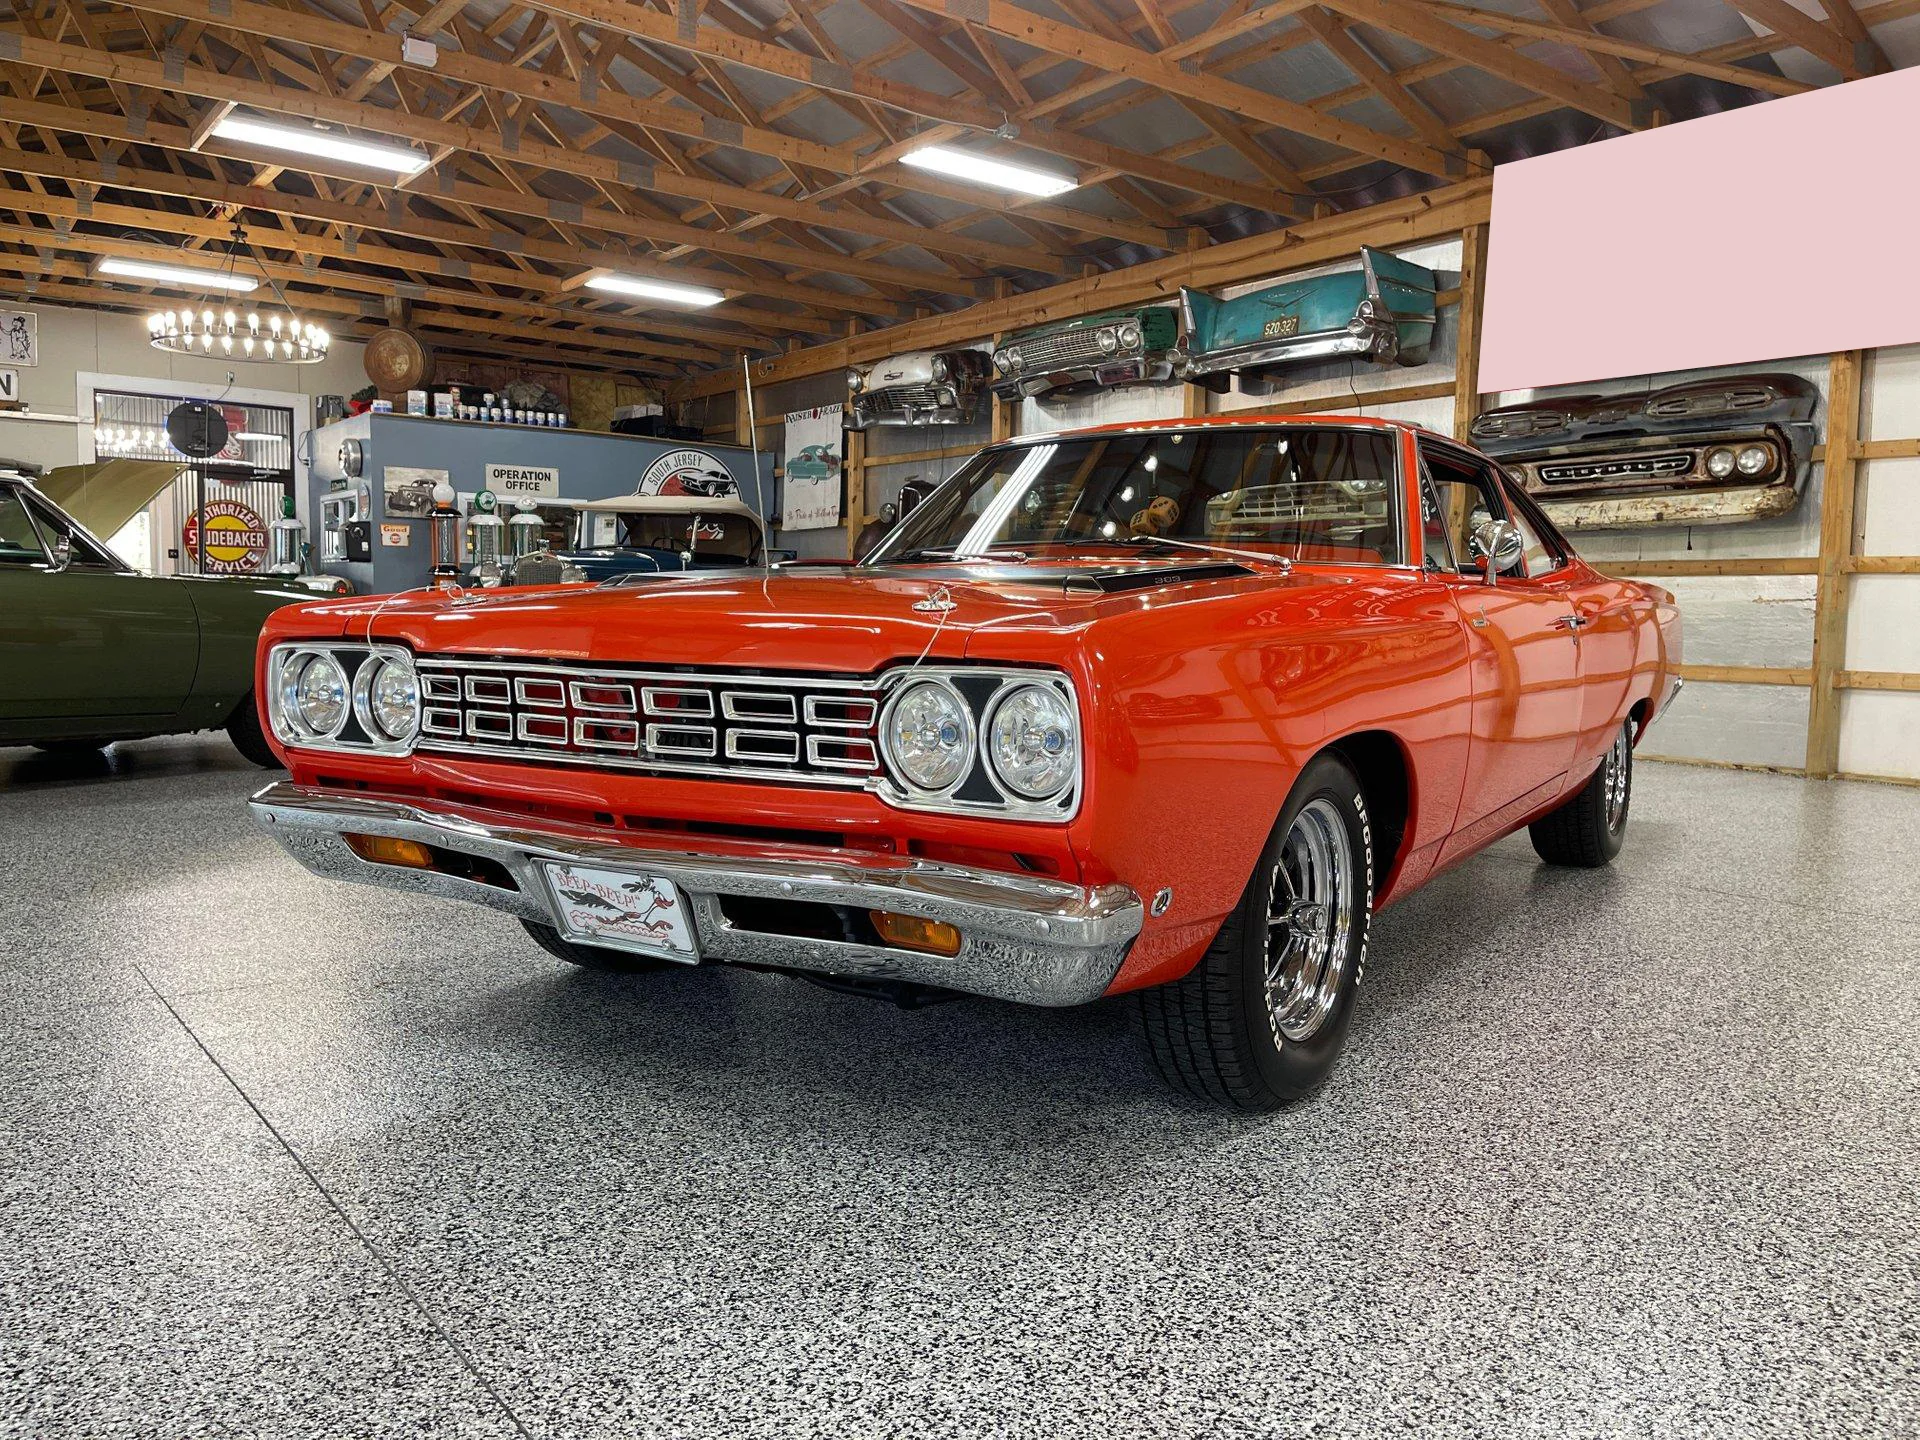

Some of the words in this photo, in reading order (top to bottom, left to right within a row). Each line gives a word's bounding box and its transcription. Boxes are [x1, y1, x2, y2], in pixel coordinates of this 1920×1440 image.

[493, 468, 551, 482] OPERATION
[647, 459, 672, 486] SOUTH
[673, 453, 703, 468] JERSEY
[505, 480, 540, 491] OFFICE
[194, 503, 260, 530] UTHORIZED
[189, 529, 264, 547] SUDEBAKER
[195, 551, 259, 572] ERVICE
[1353, 793, 1373, 987] BFGoodrich
